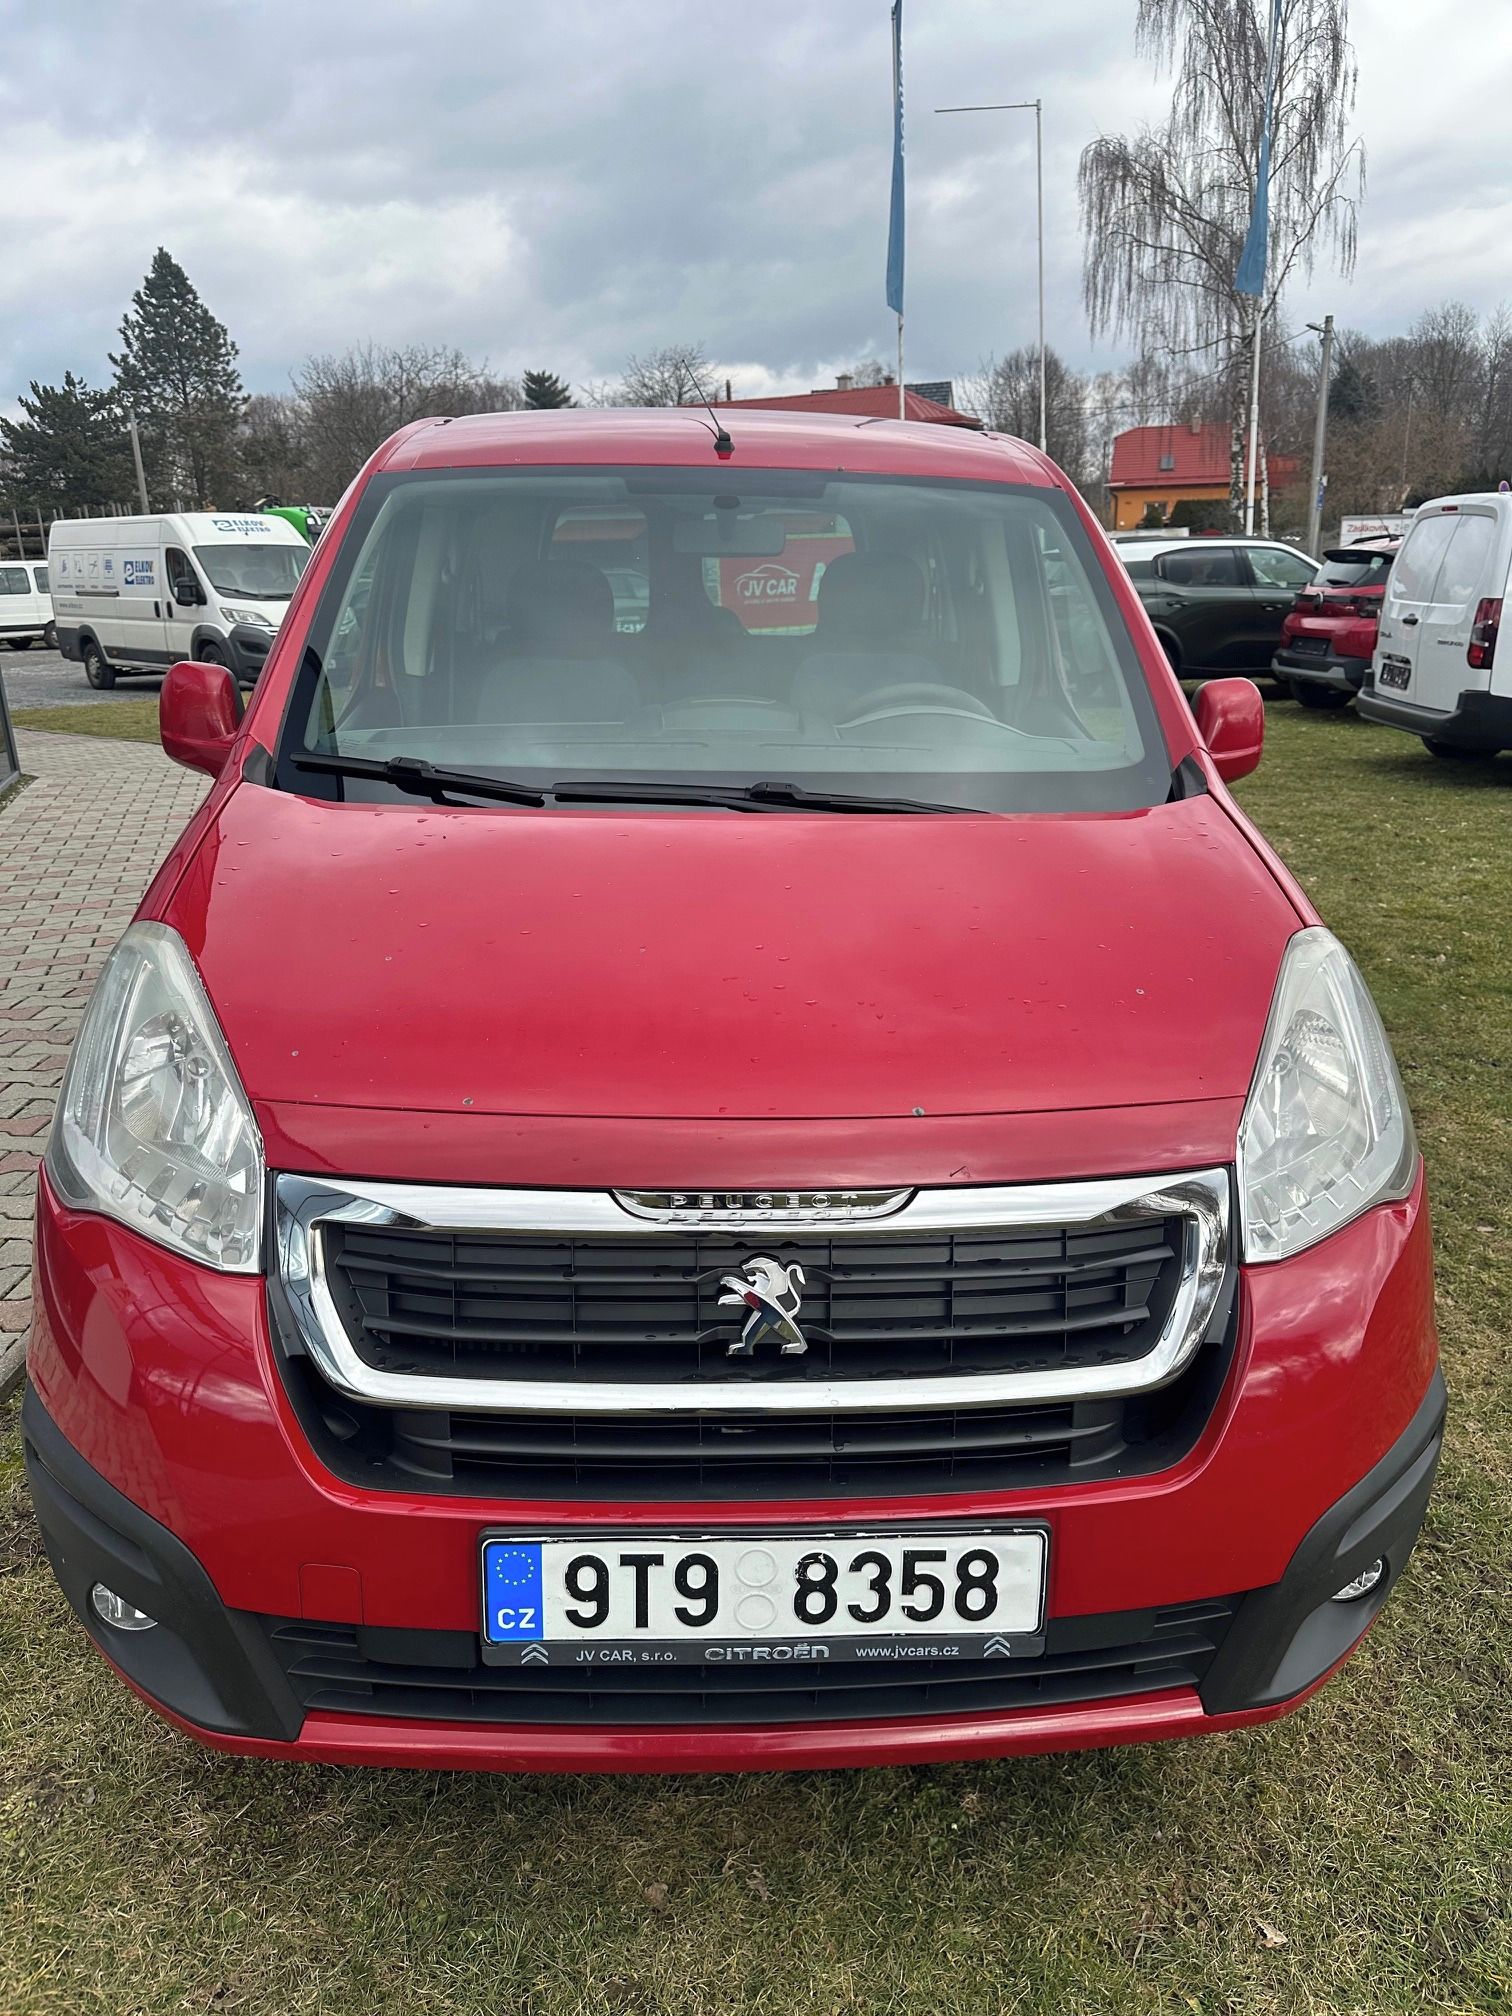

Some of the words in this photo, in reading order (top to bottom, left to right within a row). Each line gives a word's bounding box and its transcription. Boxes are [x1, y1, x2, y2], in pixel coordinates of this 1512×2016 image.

[744, 580, 764, 596] JV
[766, 578, 797, 595] CAR
[669, 1193, 859, 1209] PEUGEOT
[563, 1551, 719, 1629] 9T9
[793, 1547, 1000, 1627] 8358
[496, 1608, 536, 1629] CZ
[576, 1649, 595, 1662] JV
[599, 1649, 637, 1664] CAR,
[641, 1650, 677, 1662] s.r.o.
[856, 1645, 960, 1659] www.jvcars.cz
